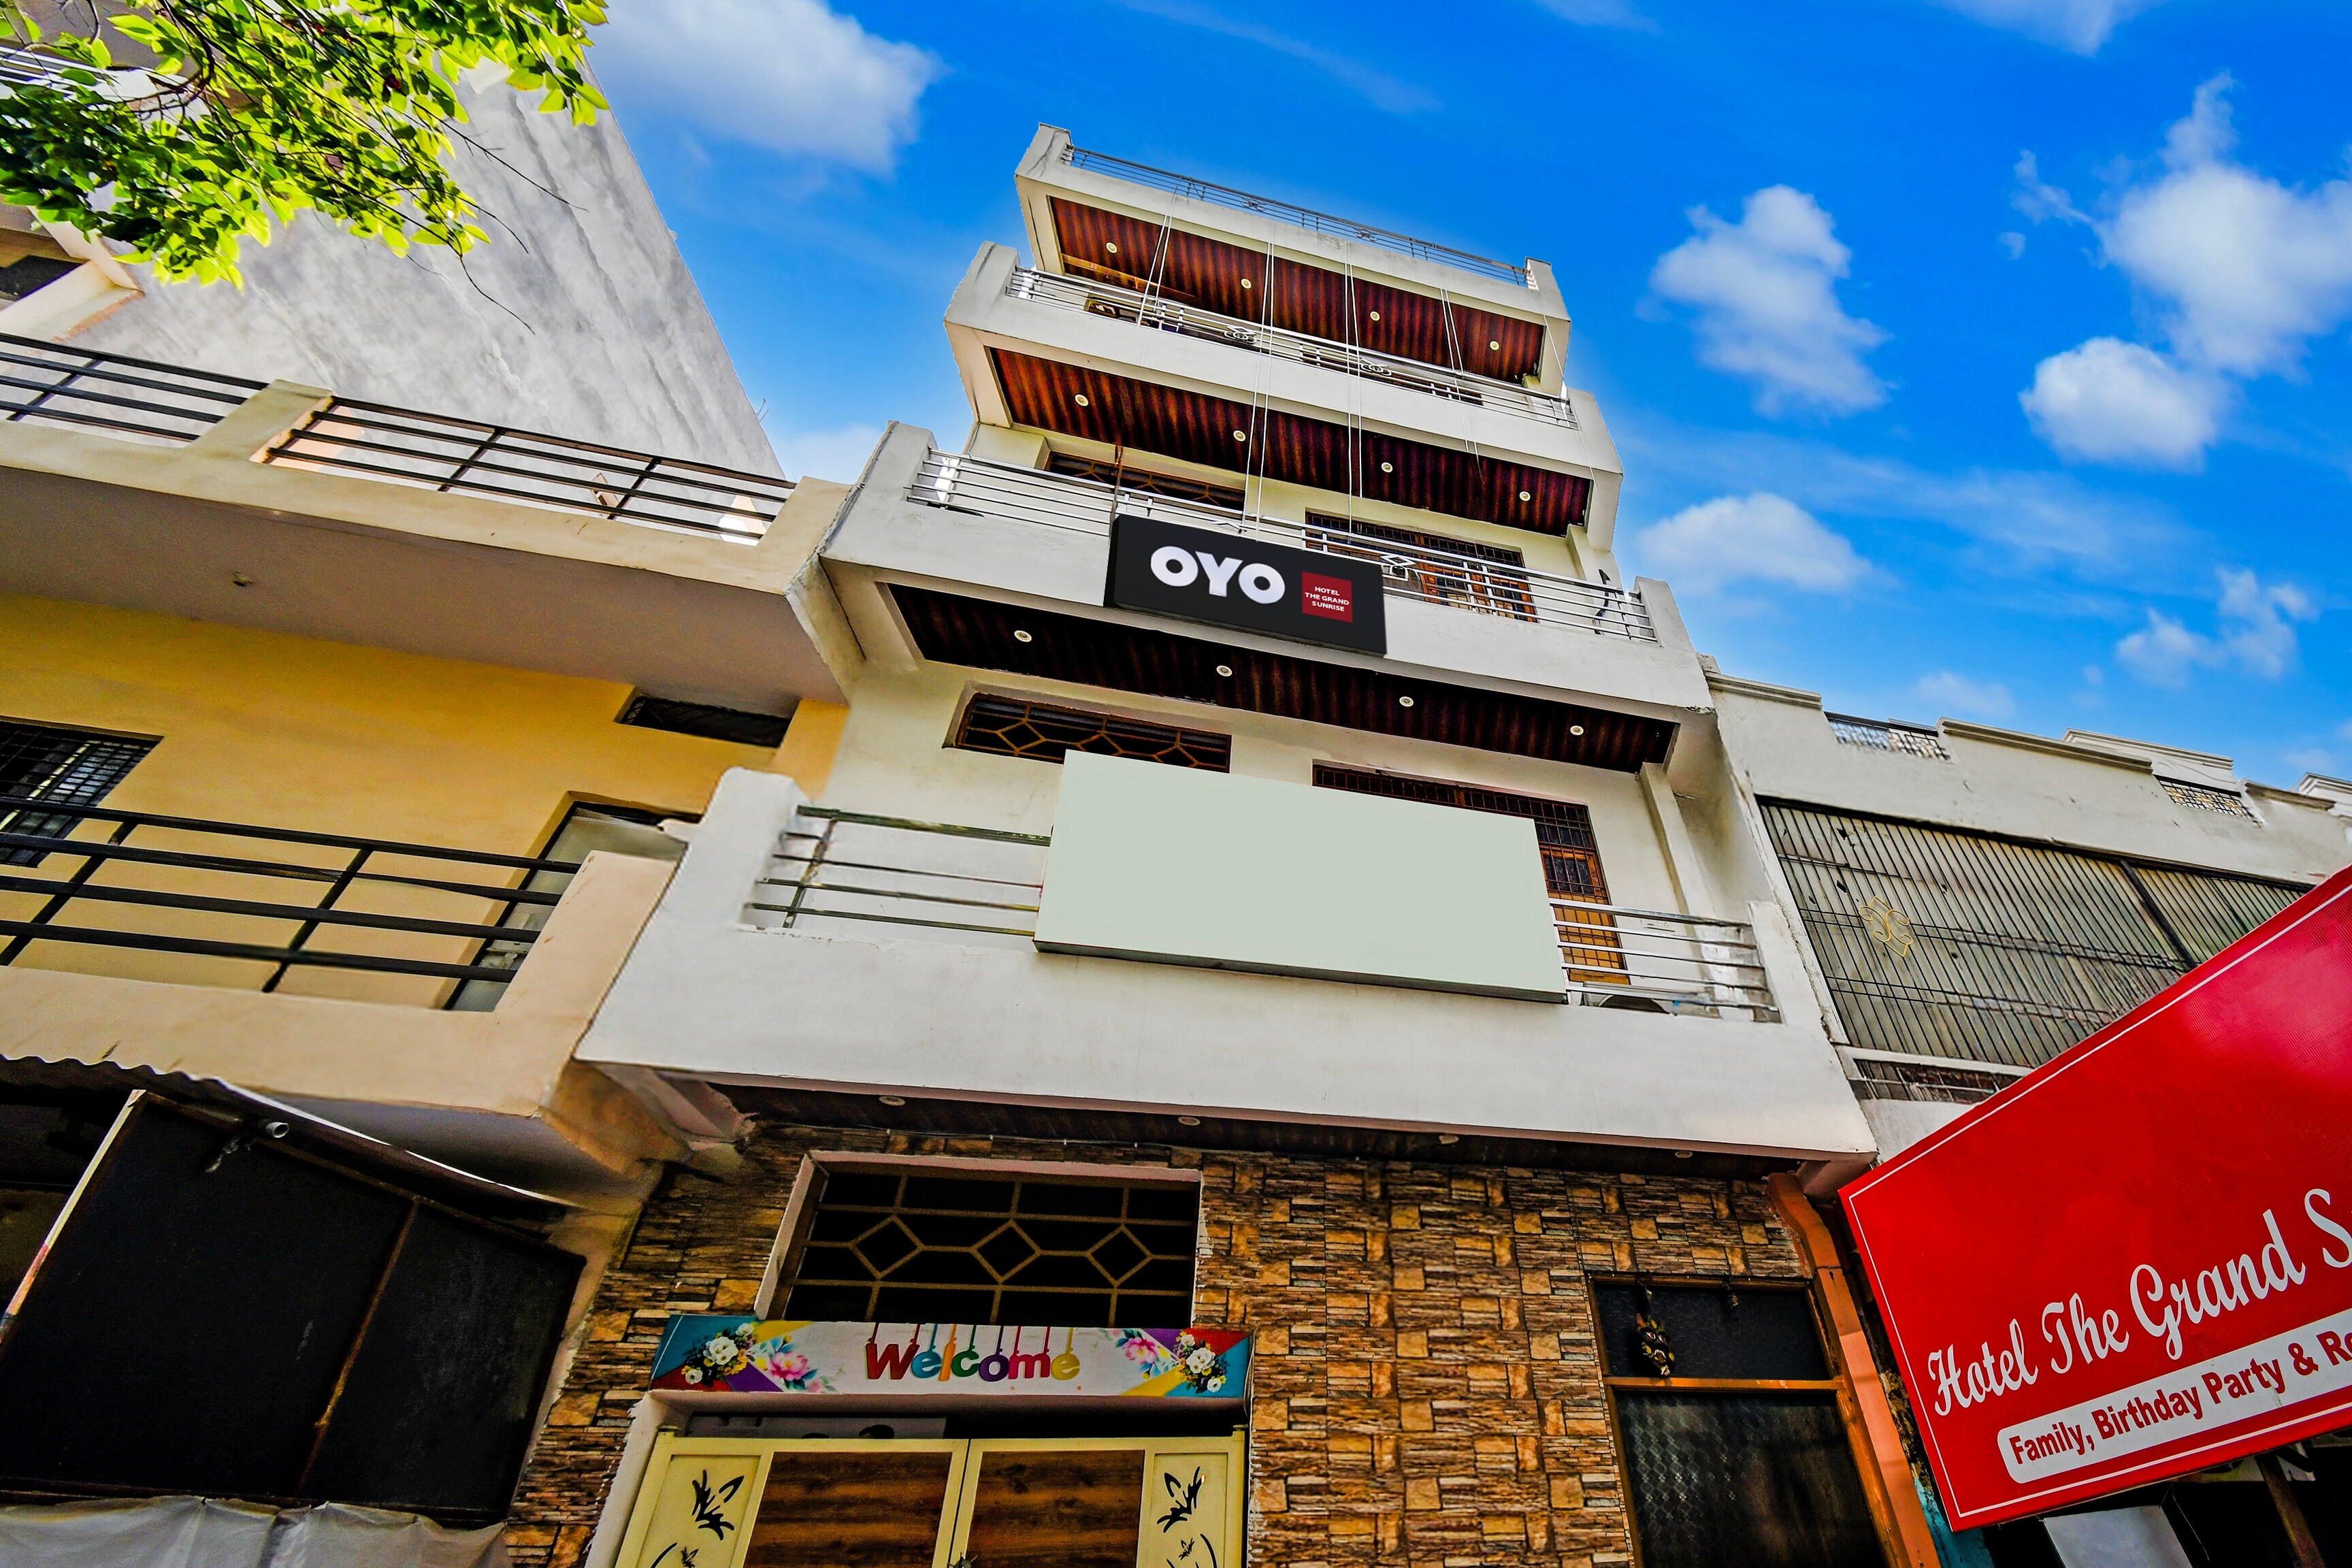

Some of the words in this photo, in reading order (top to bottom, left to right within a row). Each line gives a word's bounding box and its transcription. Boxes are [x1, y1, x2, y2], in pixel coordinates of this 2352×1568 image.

[1150, 546, 1286, 604] OYO
[1315, 586, 1340, 596] HOTEL
[1311, 600, 1345, 612] SUNRISE
[1322, 595, 1350, 606] GRAND
[1927, 1318, 2038, 1416] Hotel
[2042, 1292, 2129, 1374] The
[2129, 1209, 2306, 1360] Grand
[865, 1341, 1081, 1382] Welcome
[2009, 1422, 2095, 1465] Family,
[2092, 1386, 2203, 1439] Birthday
[2202, 1358, 2285, 1405] Party
[2288, 1343, 2319, 1376] &
